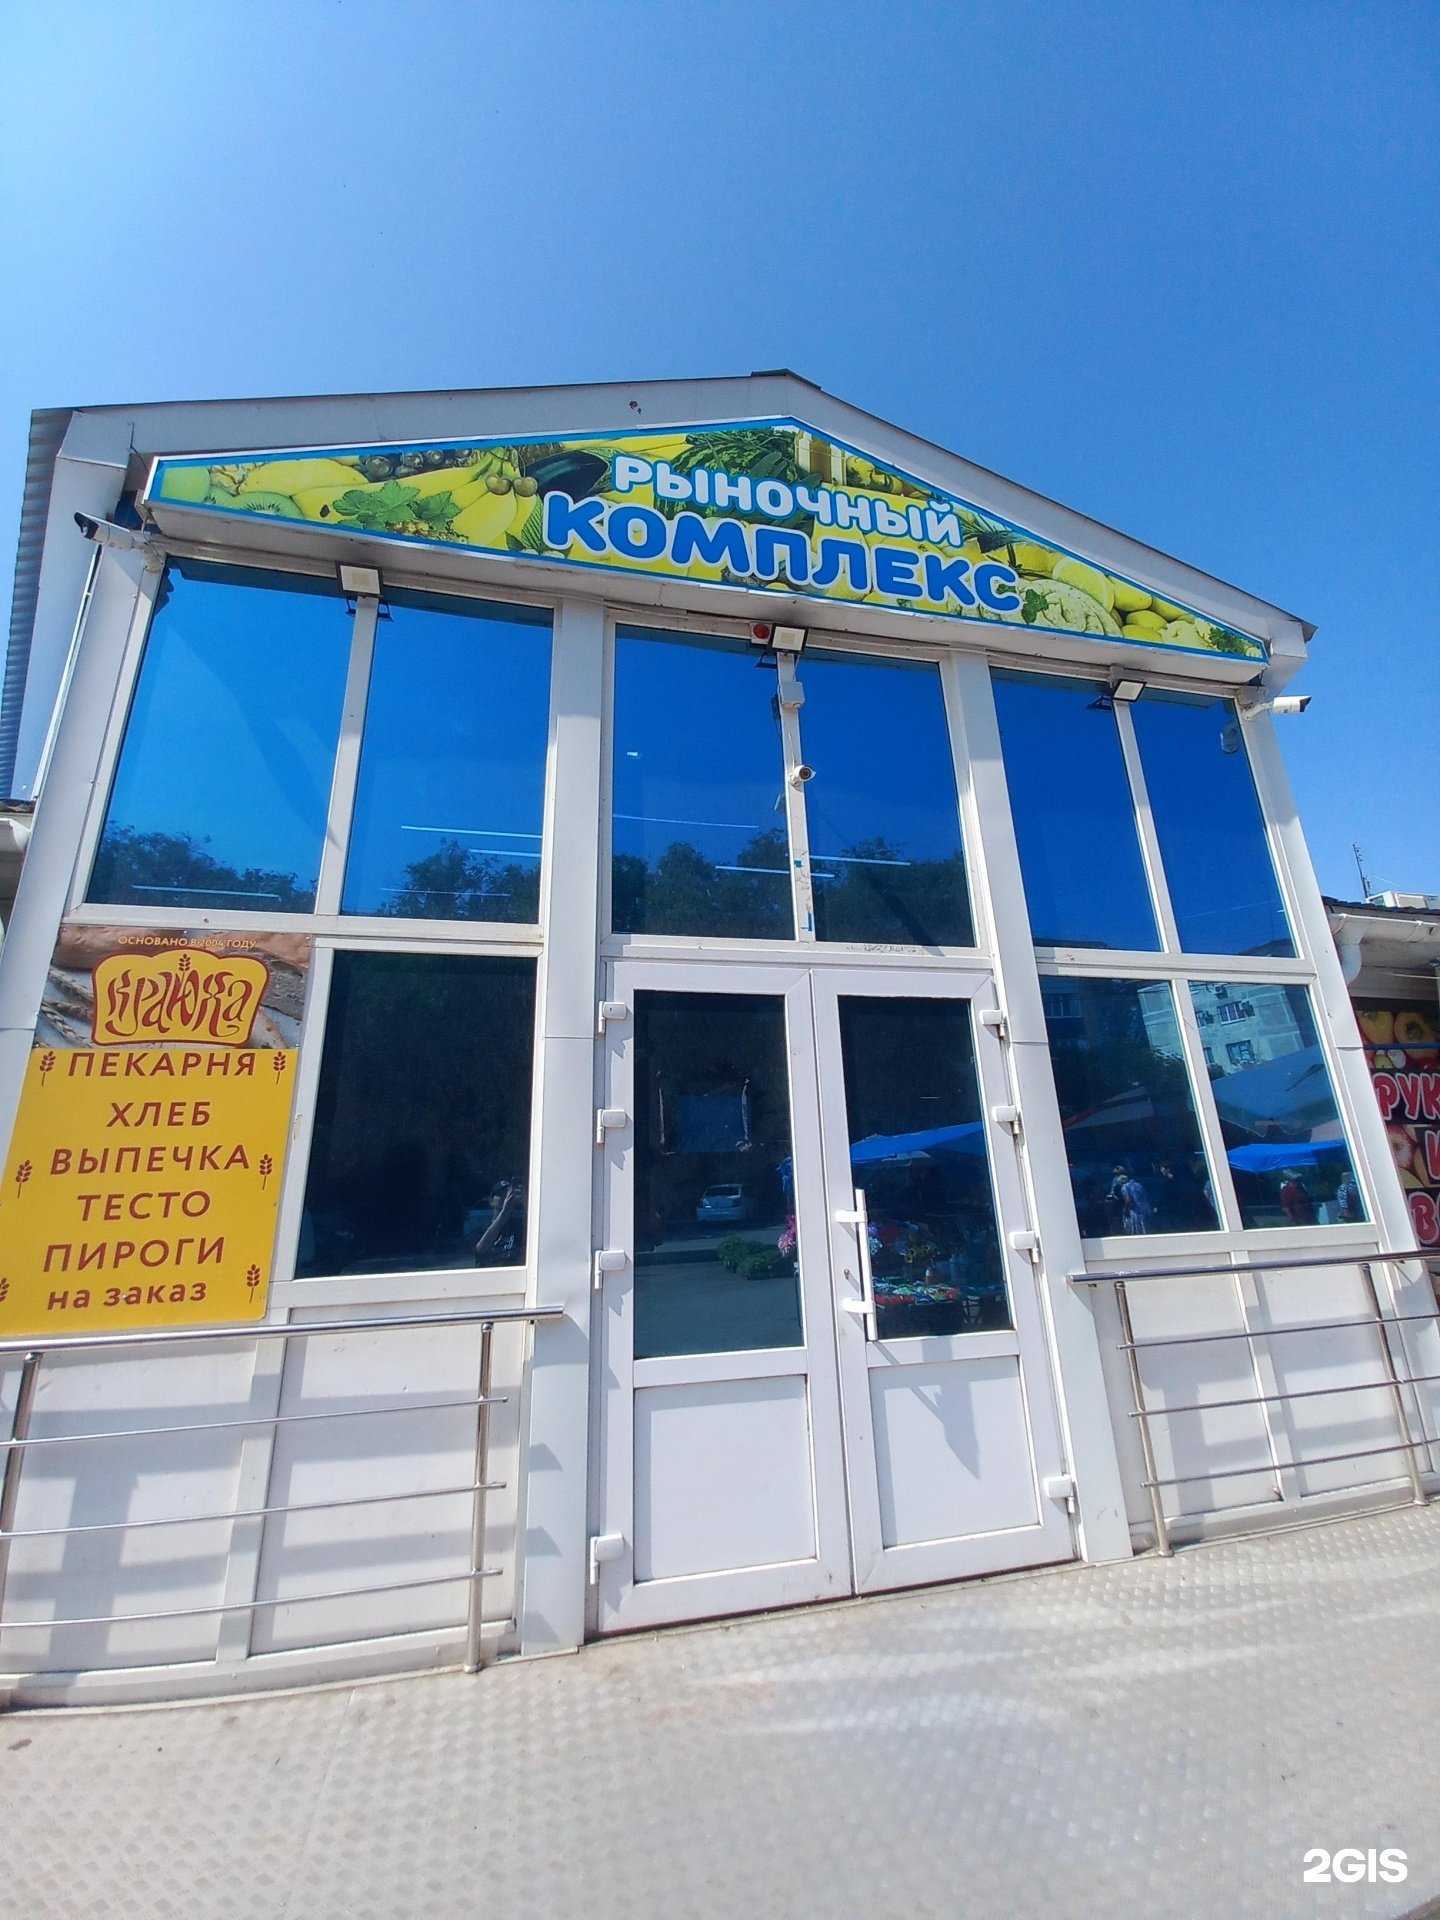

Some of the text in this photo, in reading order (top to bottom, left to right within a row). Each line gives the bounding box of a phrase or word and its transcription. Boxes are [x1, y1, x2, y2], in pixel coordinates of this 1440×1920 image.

[614, 455, 965, 547] РЫНОЧНЫЙ
[542, 490, 1025, 613] КОМПЛЕКС
[118, 936, 187, 947] ОСНОВАНО
[226, 940, 257, 951] ГОДУ
[67, 1052, 256, 1077] ПЕКАРНЯ
[106, 1101, 211, 1128] ХЛЕБ
[50, 1145, 250, 1175] ВЫПЕЧКА
[77, 1191, 211, 1221] ТЕСТО
[42, 1237, 225, 1272] ПИРОГИ
[47, 1282, 207, 1311] на заказ
